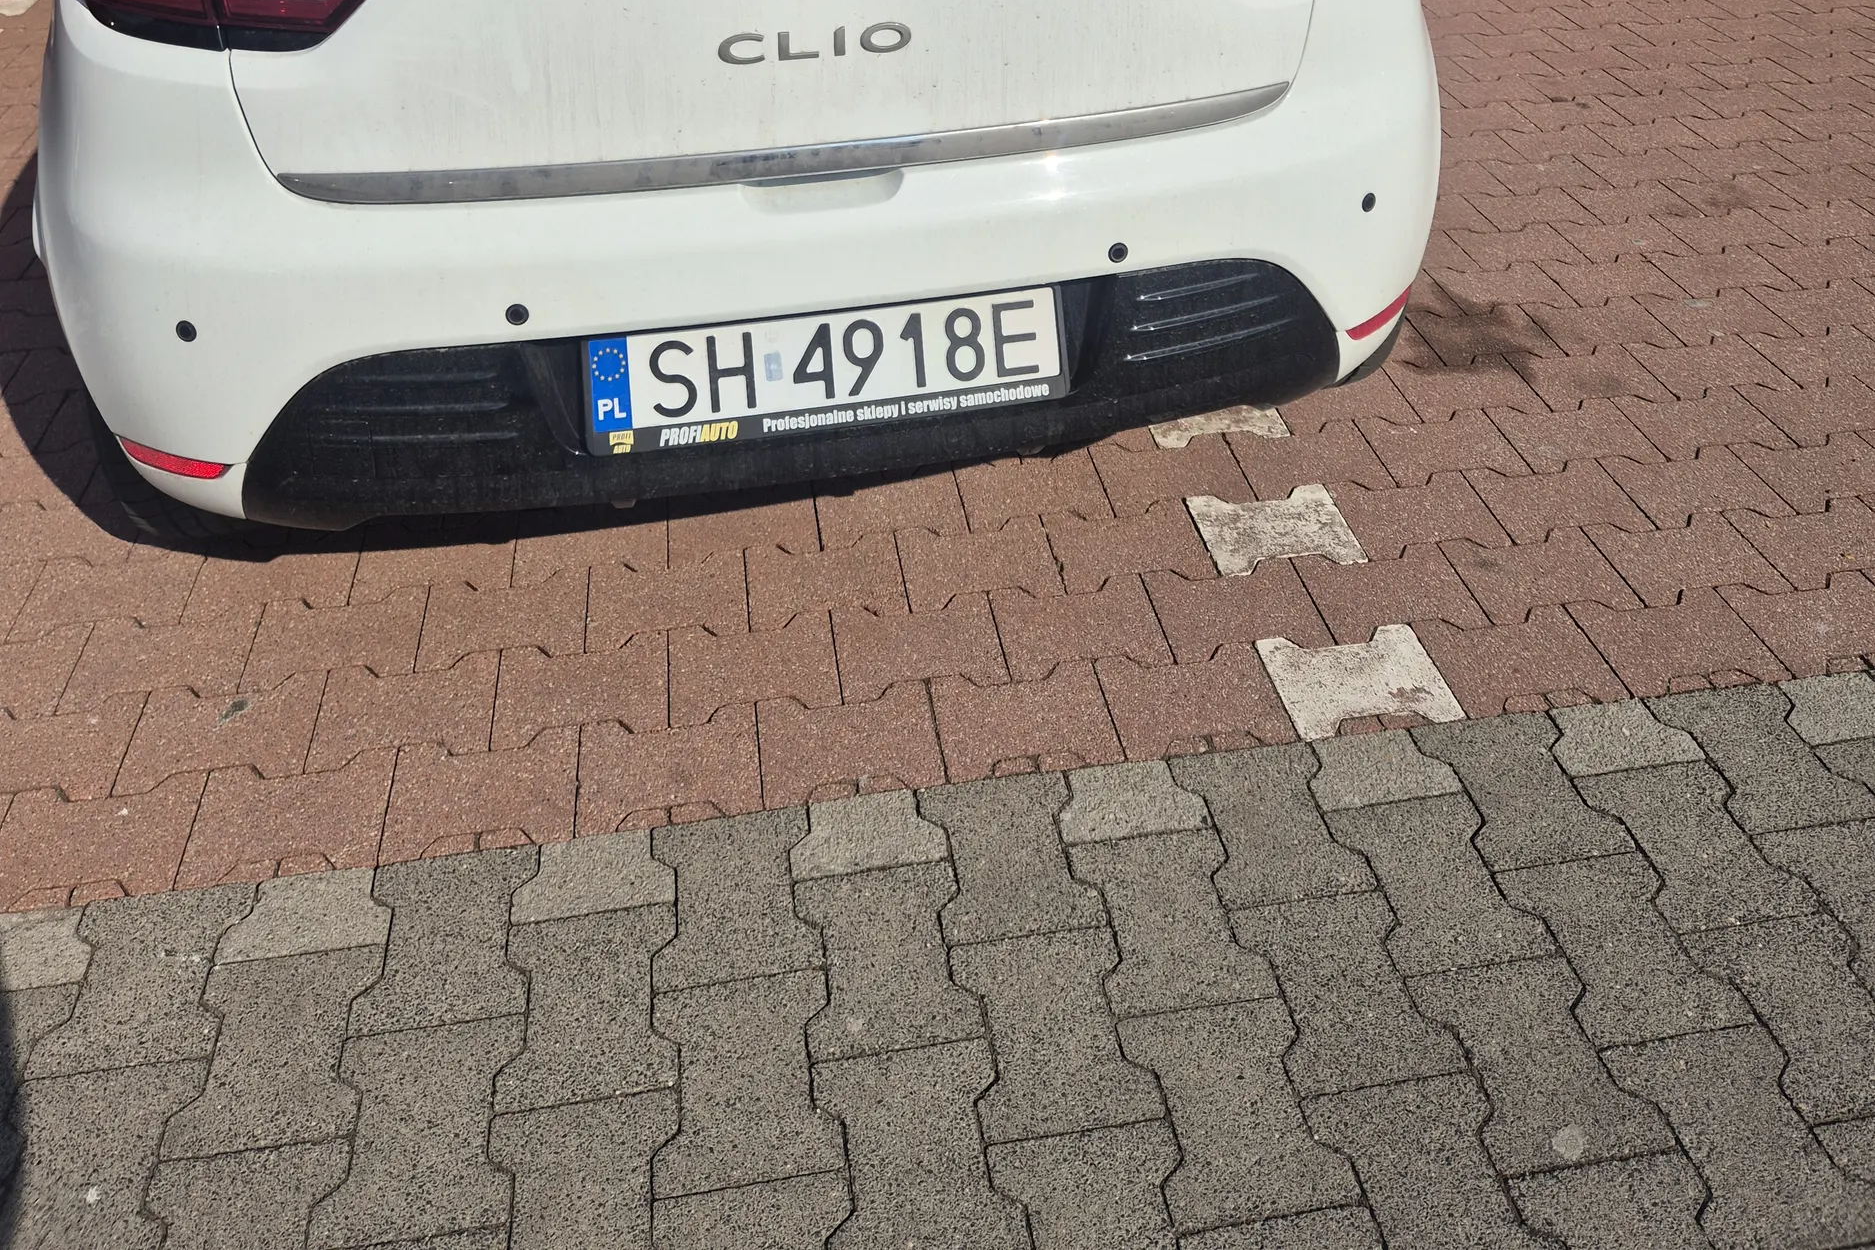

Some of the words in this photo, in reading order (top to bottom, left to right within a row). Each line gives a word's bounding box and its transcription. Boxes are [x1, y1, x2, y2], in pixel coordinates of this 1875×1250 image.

[717, 21, 912, 65] CLIO
[648, 331, 758, 418] SH
[793, 299, 1041, 400] 4918E
[597, 397, 627, 421] PL
[659, 420, 739, 447] PROFIAUTO
[762, 409, 855, 433] Profesjonalne
[857, 406, 899, 421] sklepy
[901, 404, 906, 416] i
[908, 399, 958, 414] serwisy
[959, 383, 1050, 408] samochodowe
